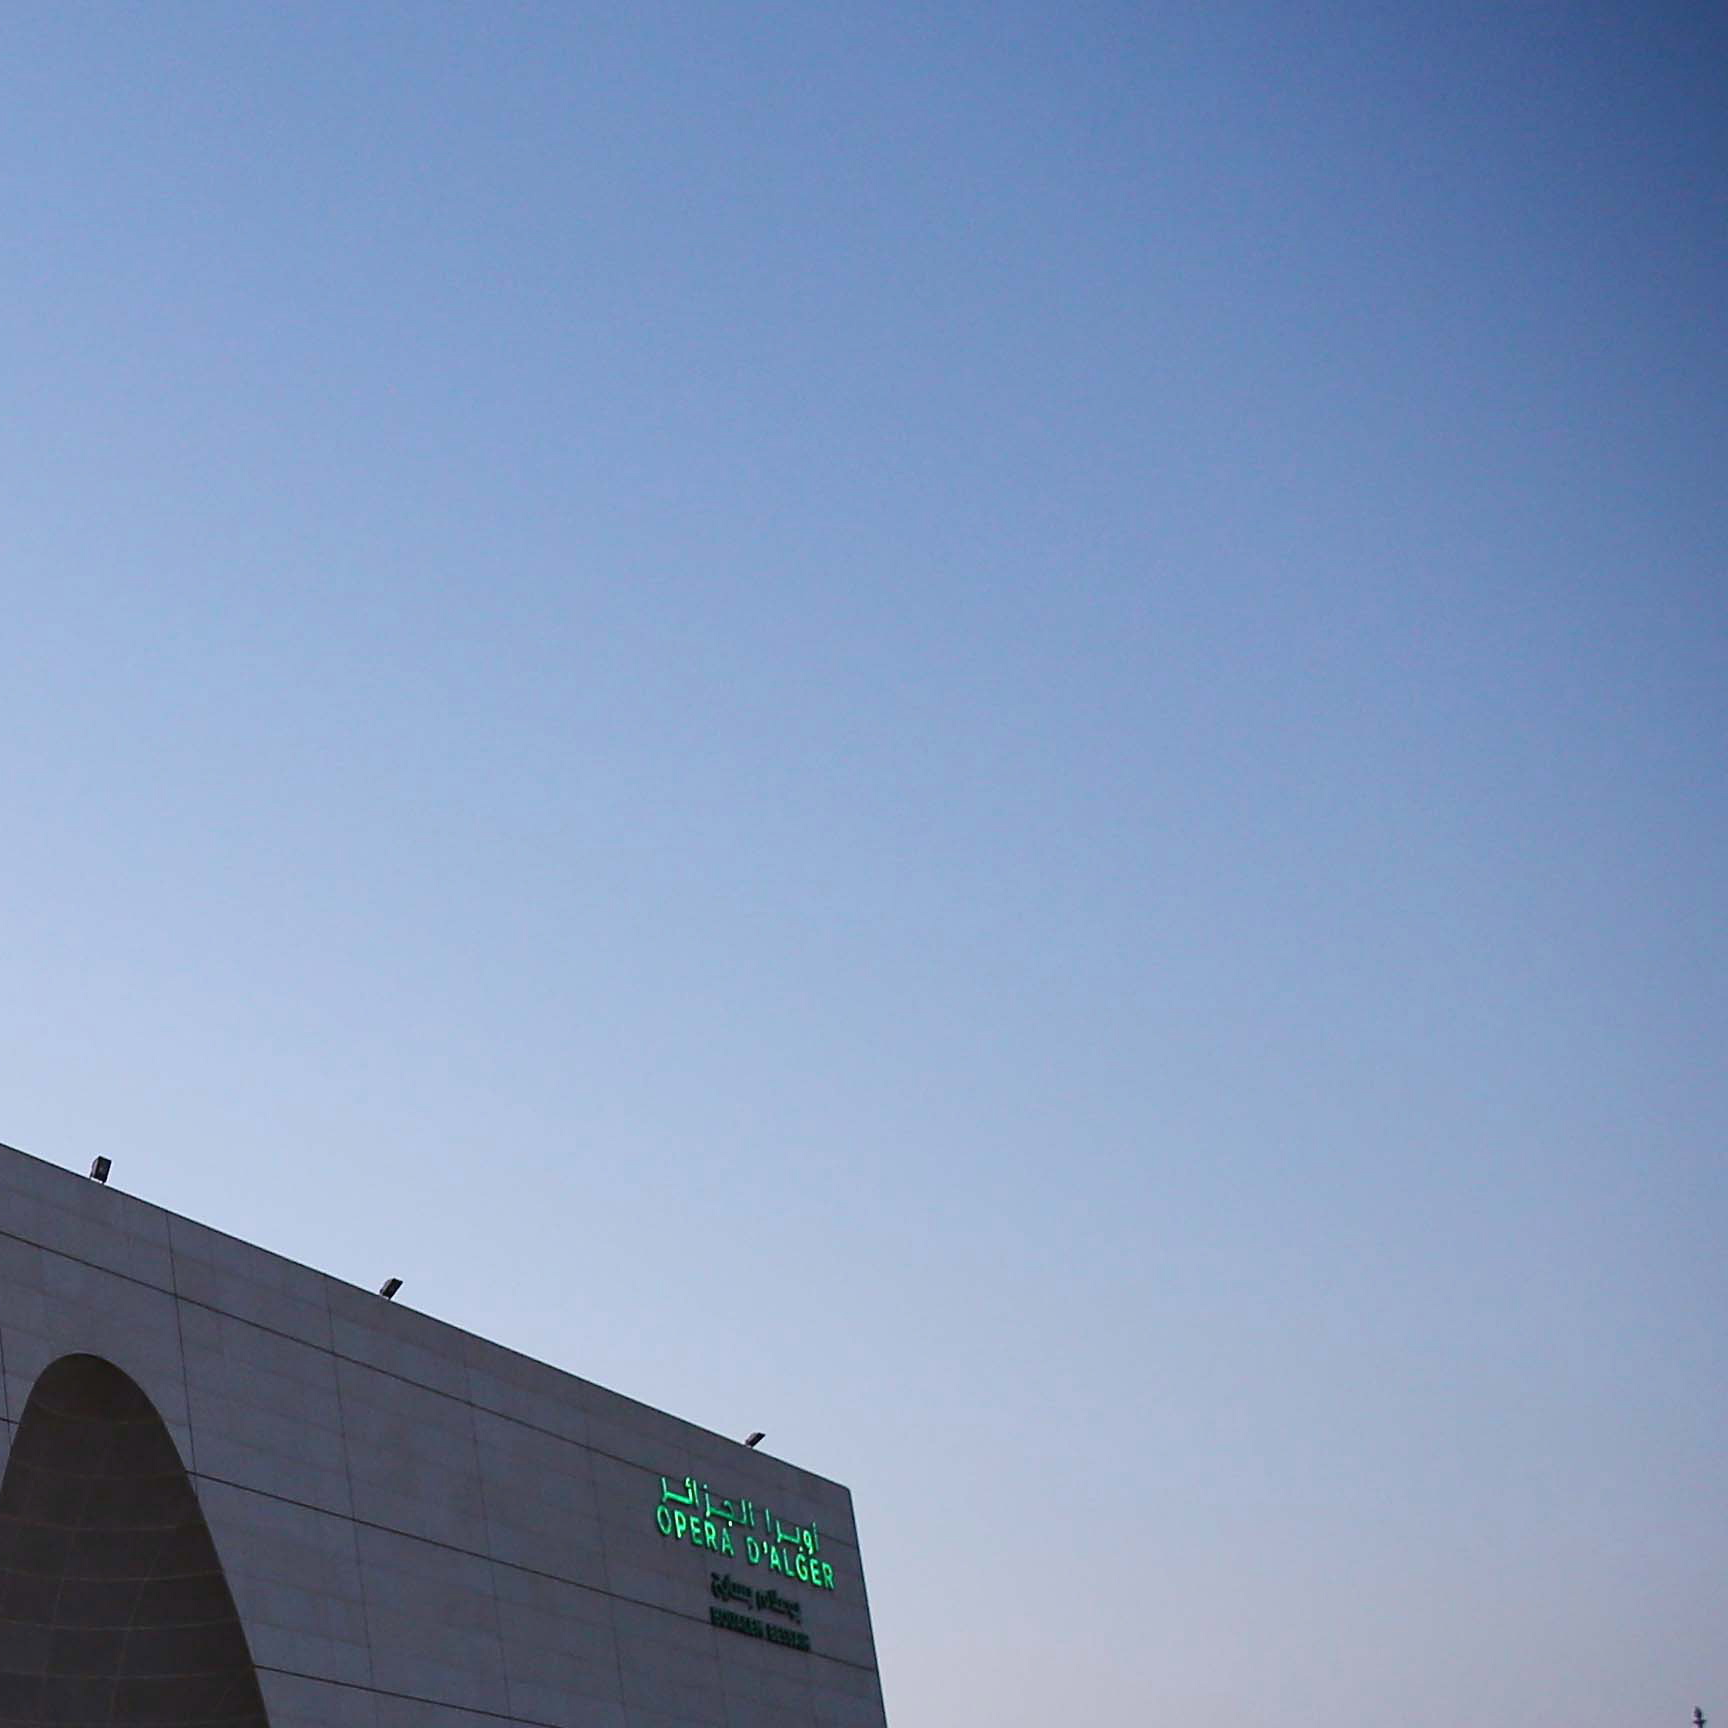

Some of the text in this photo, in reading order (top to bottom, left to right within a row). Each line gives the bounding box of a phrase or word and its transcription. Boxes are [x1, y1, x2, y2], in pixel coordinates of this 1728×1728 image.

[660, 1476, 755, 1527] الجزائر
[655, 1504, 836, 1590] OPERA D'ALGER
